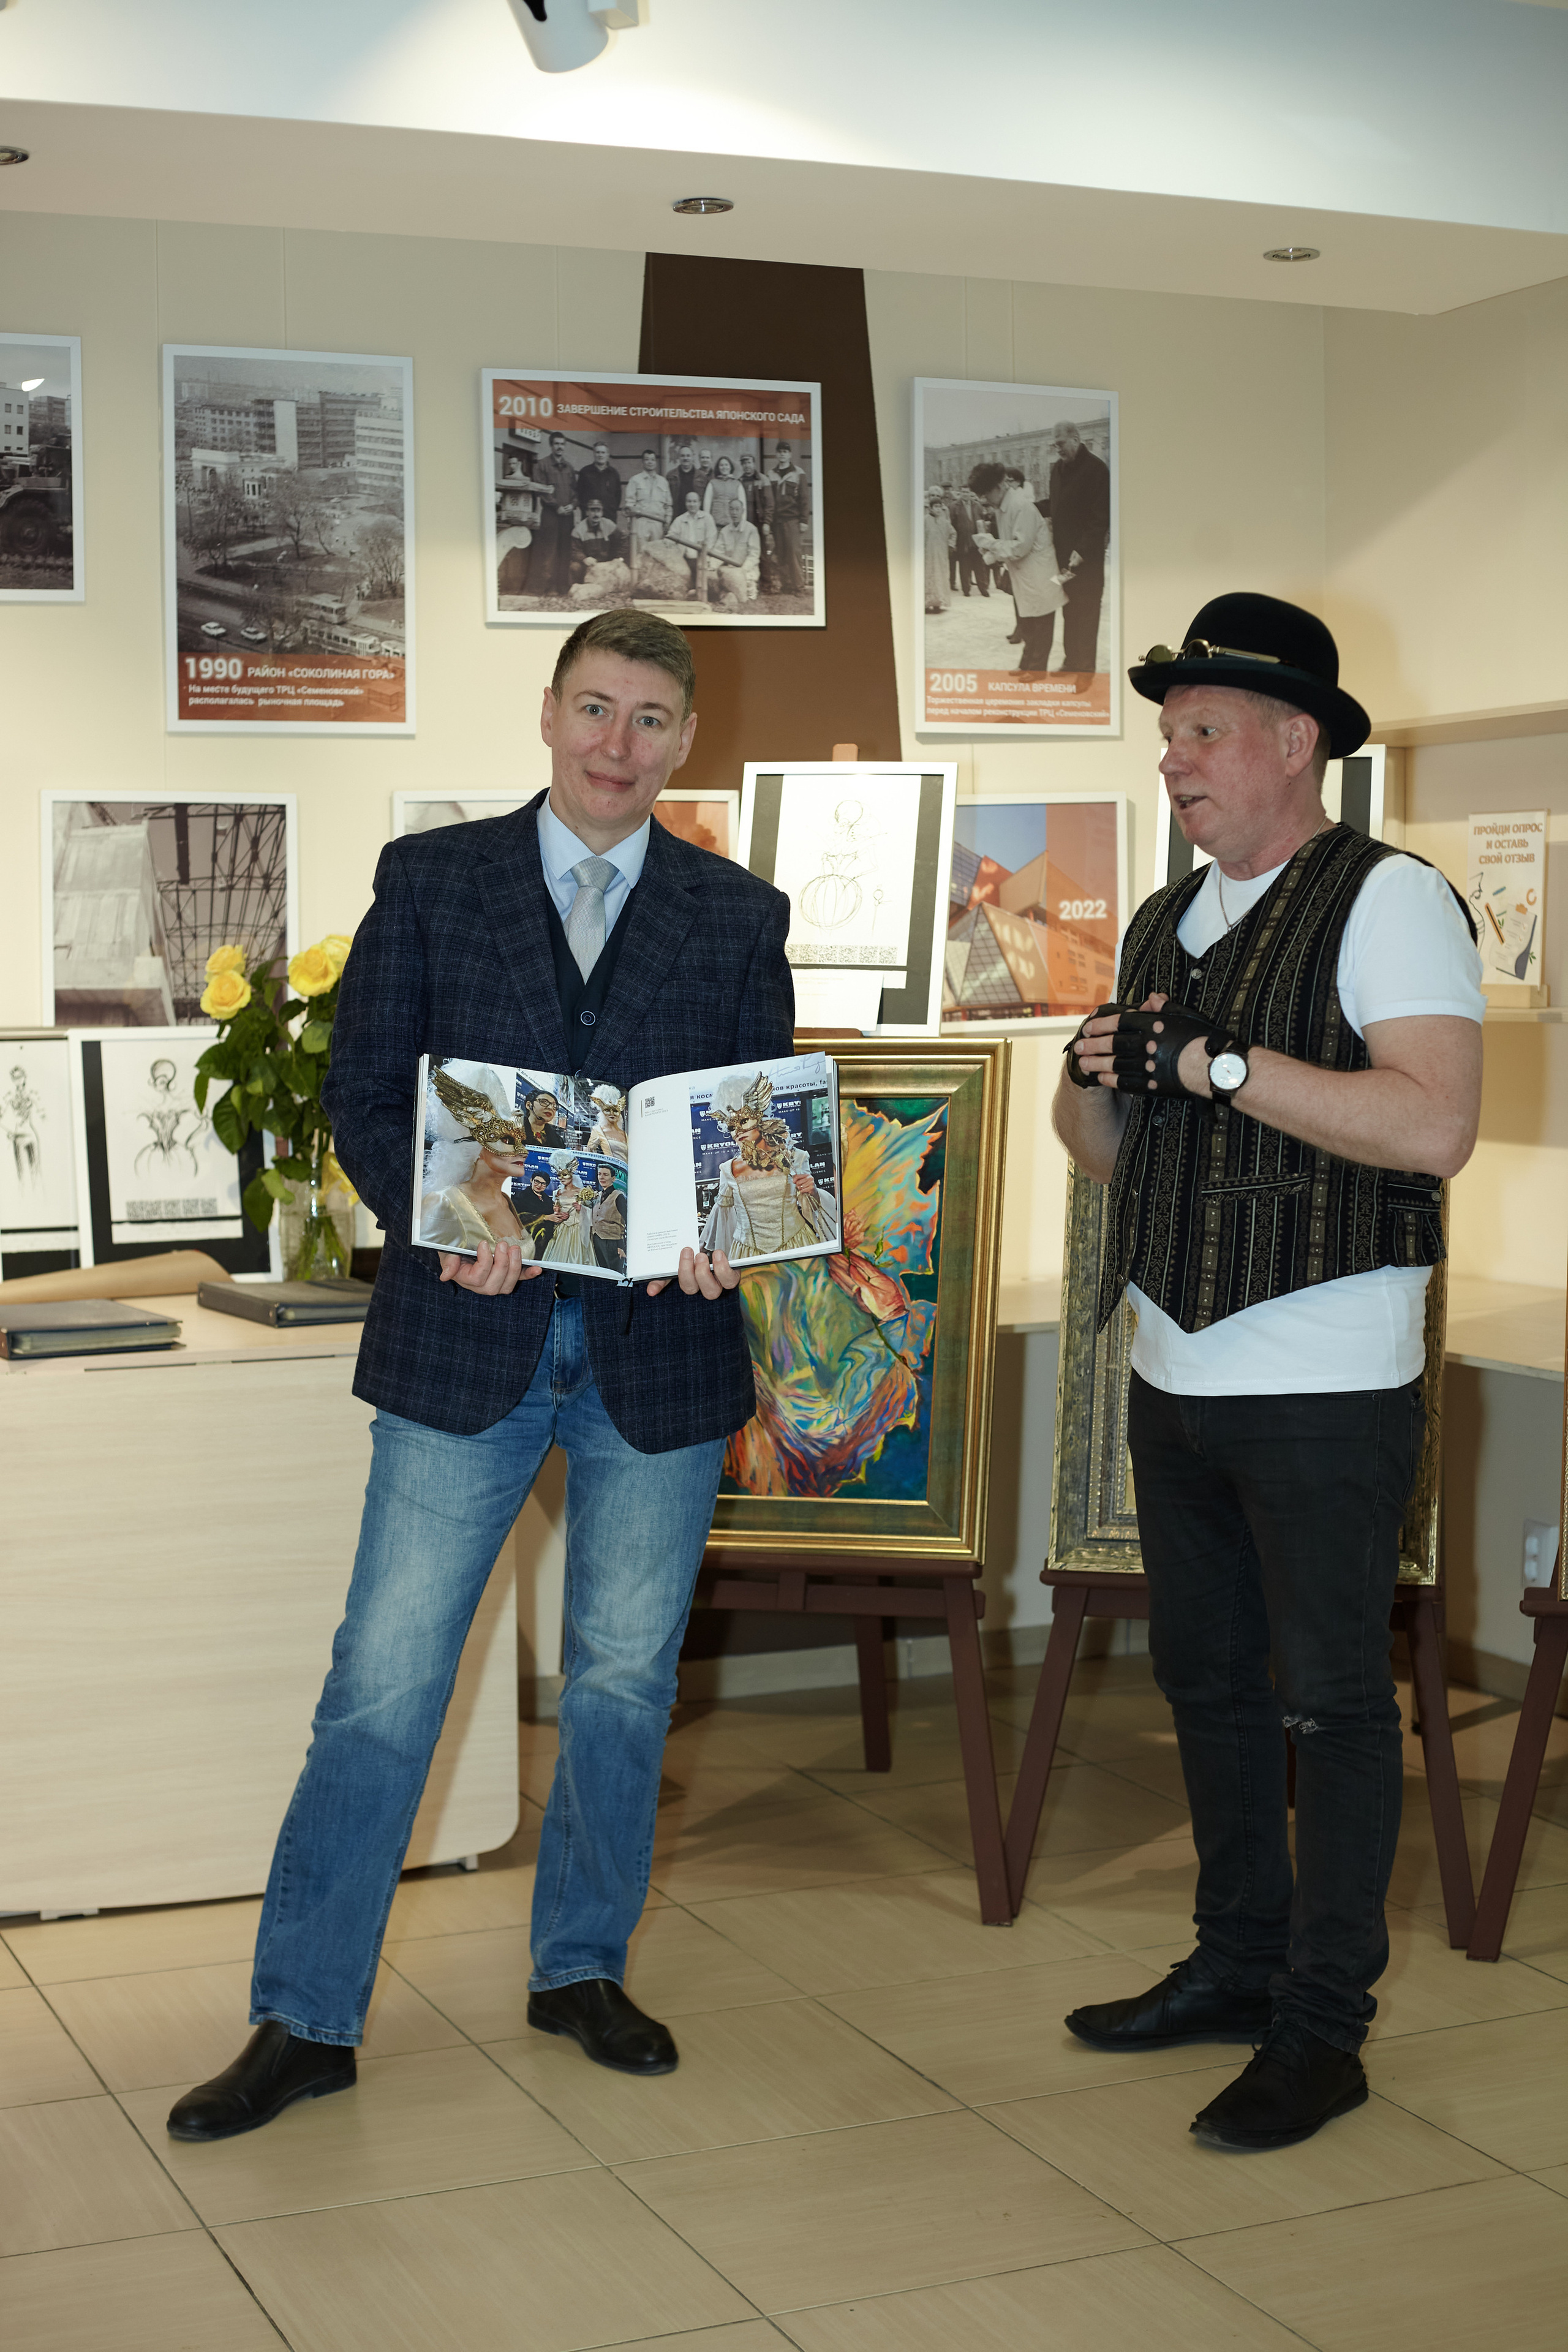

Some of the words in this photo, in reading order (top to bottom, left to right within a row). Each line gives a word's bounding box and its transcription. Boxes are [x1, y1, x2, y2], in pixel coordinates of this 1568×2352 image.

[498, 396, 552, 417] 2010
[557, 404, 628, 417] ЗАВЕРШЕНИЕ
[629, 406, 714, 420] СТРОИТЕЛЬСТВА
[715, 409, 776, 423] ЯПОНСКОГО
[777, 412, 805, 424] САДА
[186, 657, 243, 679] 1990
[247, 665, 286, 677] РАЙОН
[288, 666, 360, 679] «СОКОЛИНАЯ
[361, 669, 396, 680] ГОРА»
[929, 673, 978, 693] 2005
[987, 681, 1030, 692] КАПСУЛА
[1031, 682, 1076, 693] ВРЕМЕНИ
[188, 684, 202, 693] На
[231, 684, 275, 696] будущего
[276, 685, 296, 696] ТРЦ
[188, 696, 255, 707] располагалась
[1473, 823, 1510, 836] ПРОЙДИ
[1512, 823, 1543, 834] ОПРОС
[1486, 840, 1493, 850] И
[1494, 839, 1529, 850] ОСТАВЬ
[1479, 852, 1503, 865] СВОЙ
[1504, 853, 1535, 864] ОТЗЫВ
[1059, 900, 1107, 920] 2022
[786, 1082, 818, 1091] красоты,
